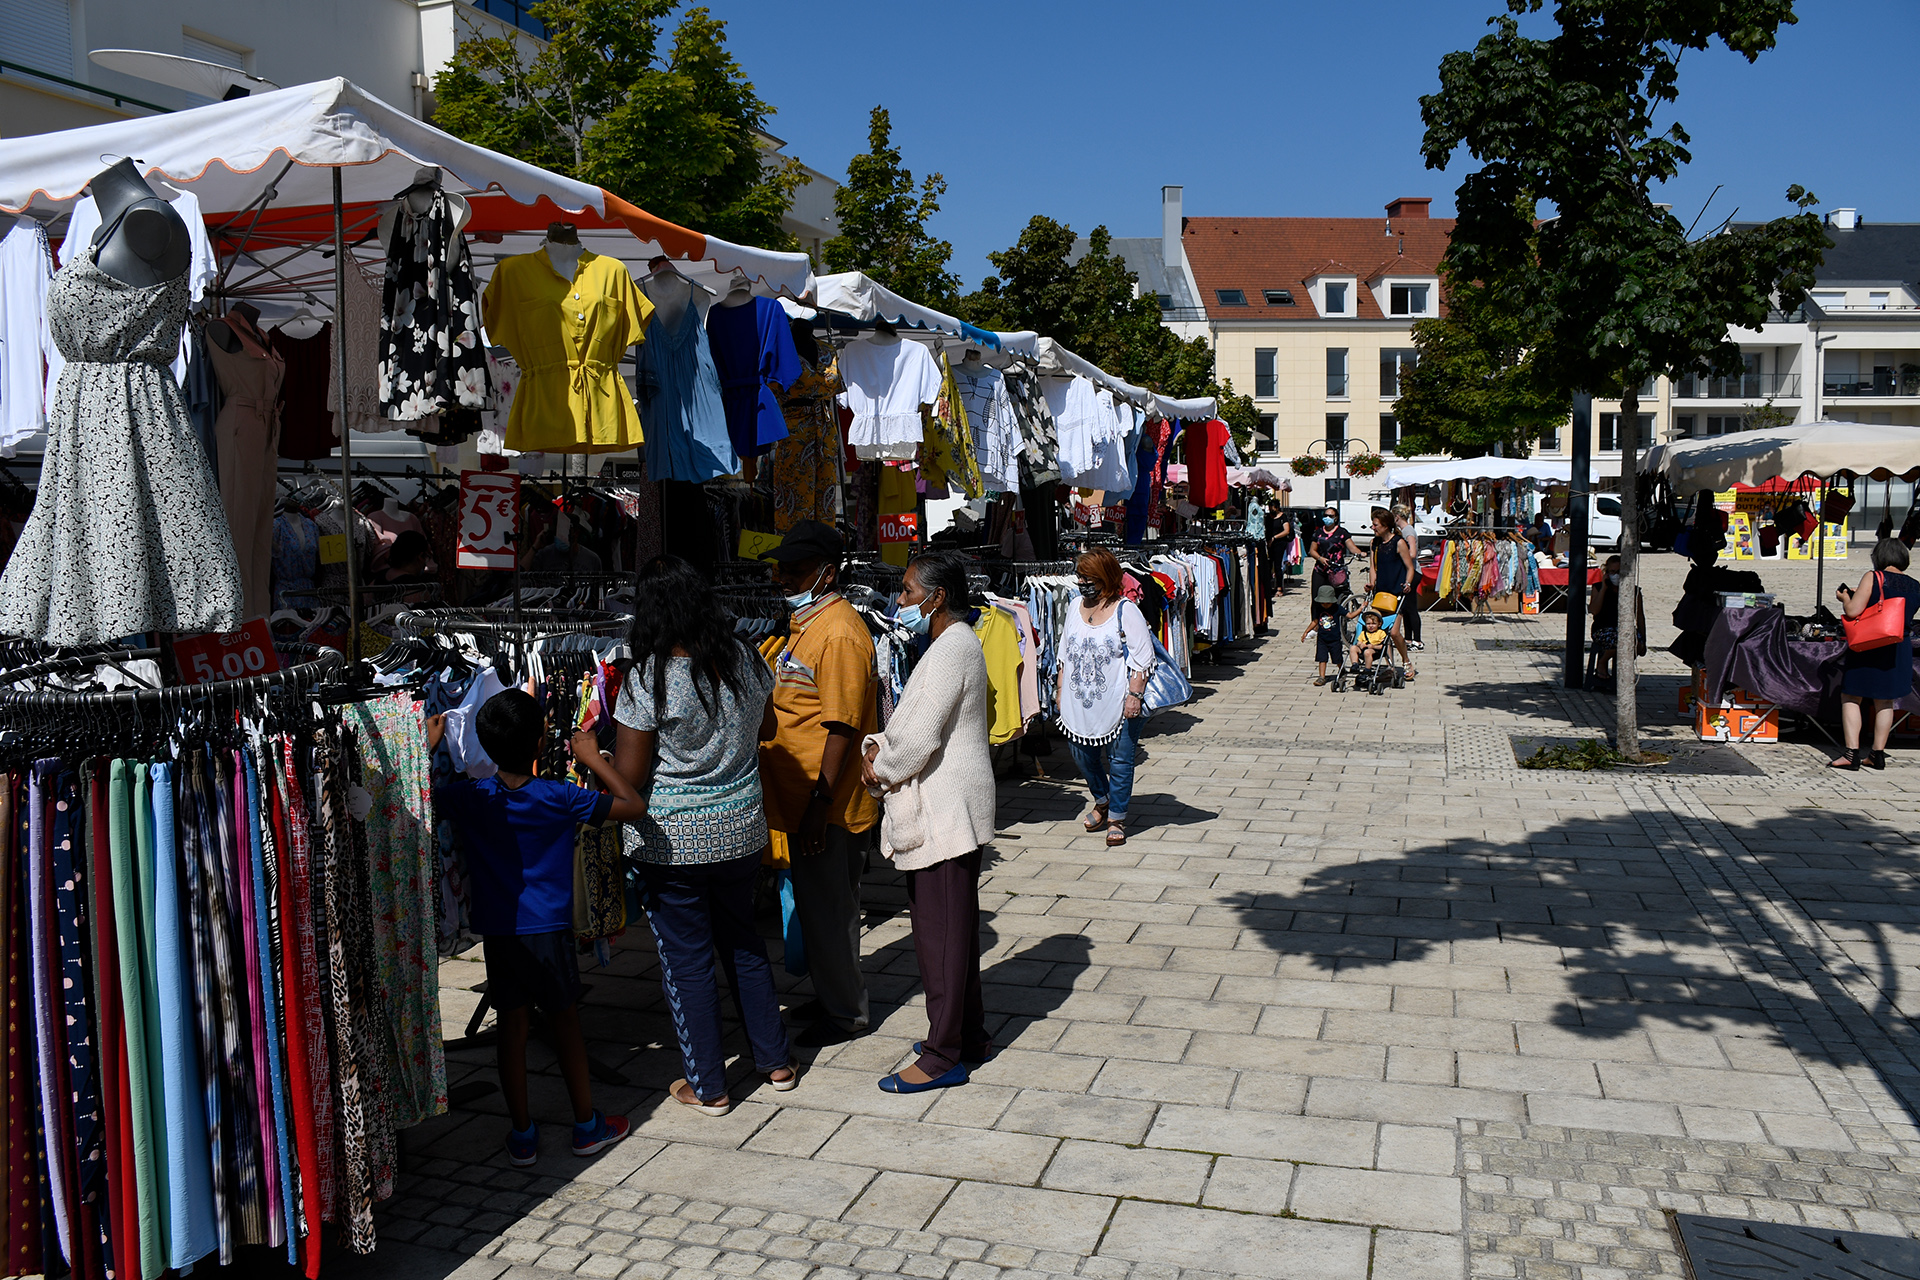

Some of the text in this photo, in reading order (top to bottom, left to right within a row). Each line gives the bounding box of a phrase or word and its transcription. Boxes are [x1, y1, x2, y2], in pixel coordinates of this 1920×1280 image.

[468, 494, 511, 542] 5€
[881, 522, 916, 541] 10,00
[1147, 515, 1161, 526] ,00
[192, 646, 266, 684] 5,00
